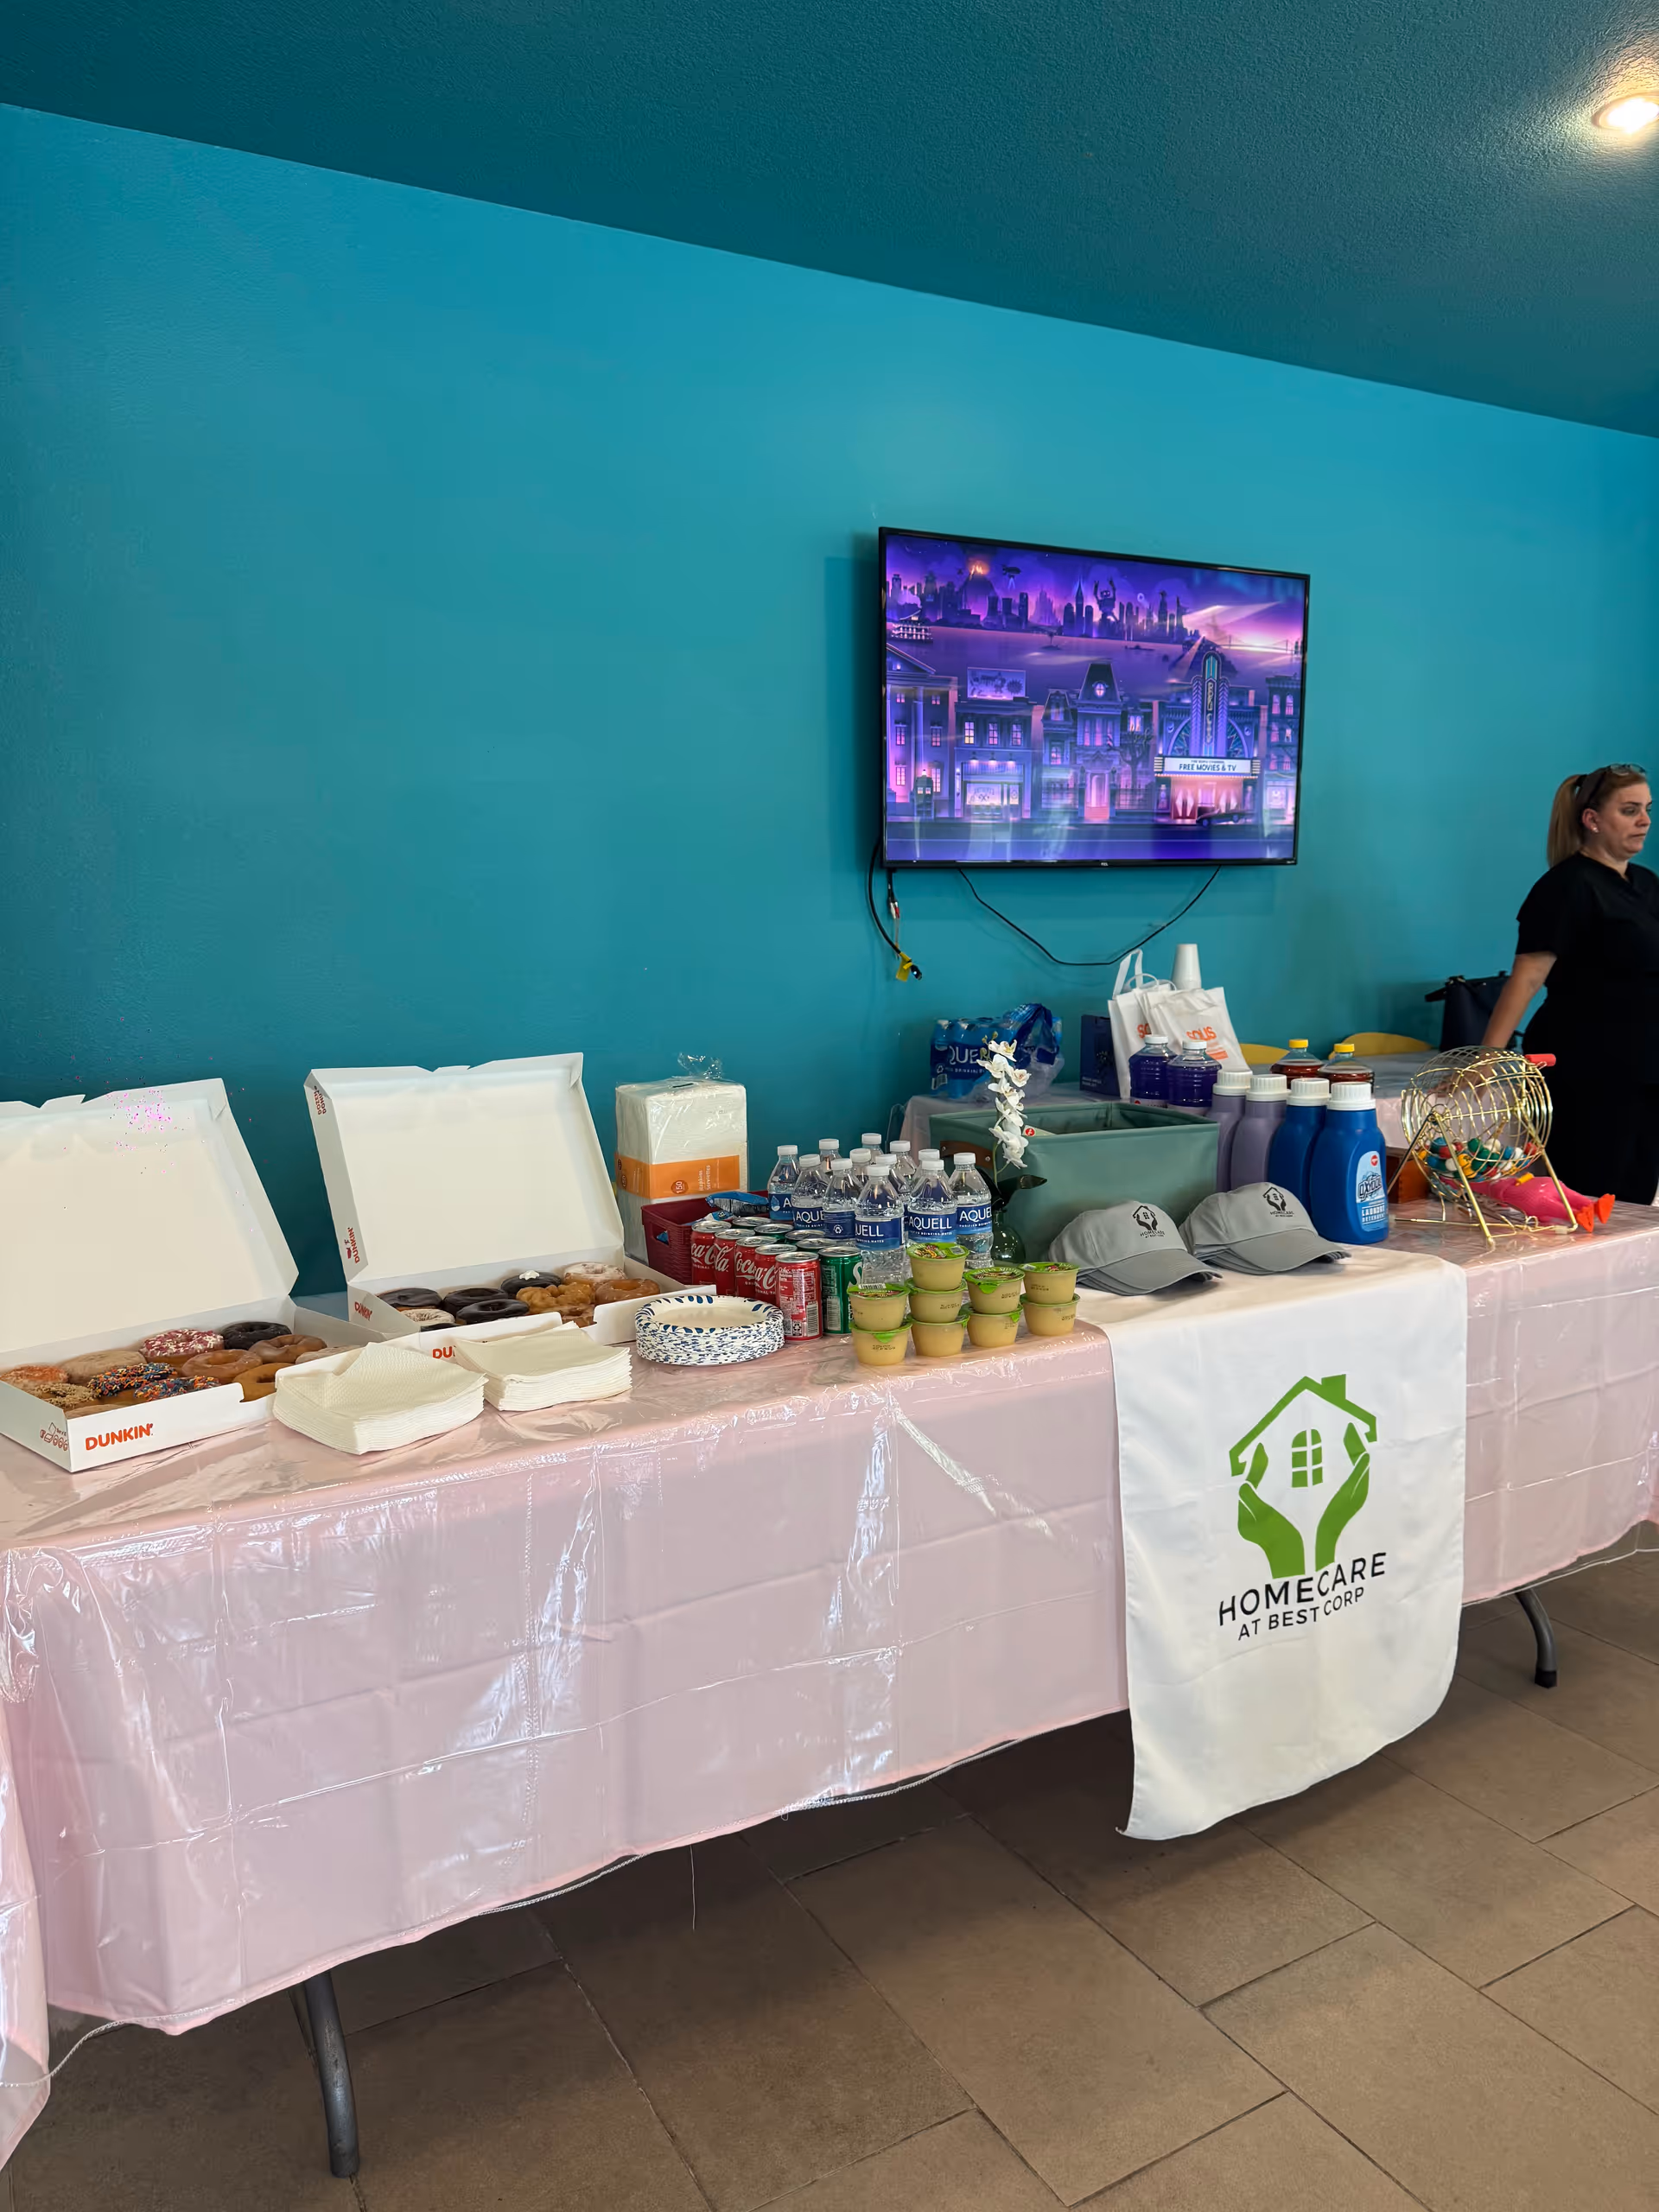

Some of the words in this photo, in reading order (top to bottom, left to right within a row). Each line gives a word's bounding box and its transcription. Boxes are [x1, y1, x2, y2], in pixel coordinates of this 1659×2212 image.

[855, 1223, 884, 1236] UELL
[908, 1216, 952, 1230] AQUELL
[85, 1422, 154, 1451] DUNKIN'
[1218, 1552, 1387, 1626] HOMECARE
[1238, 1618, 1262, 1641] AT
[1268, 1606, 1320, 1630] BEST
[1323, 1586, 1364, 1616] CORP
